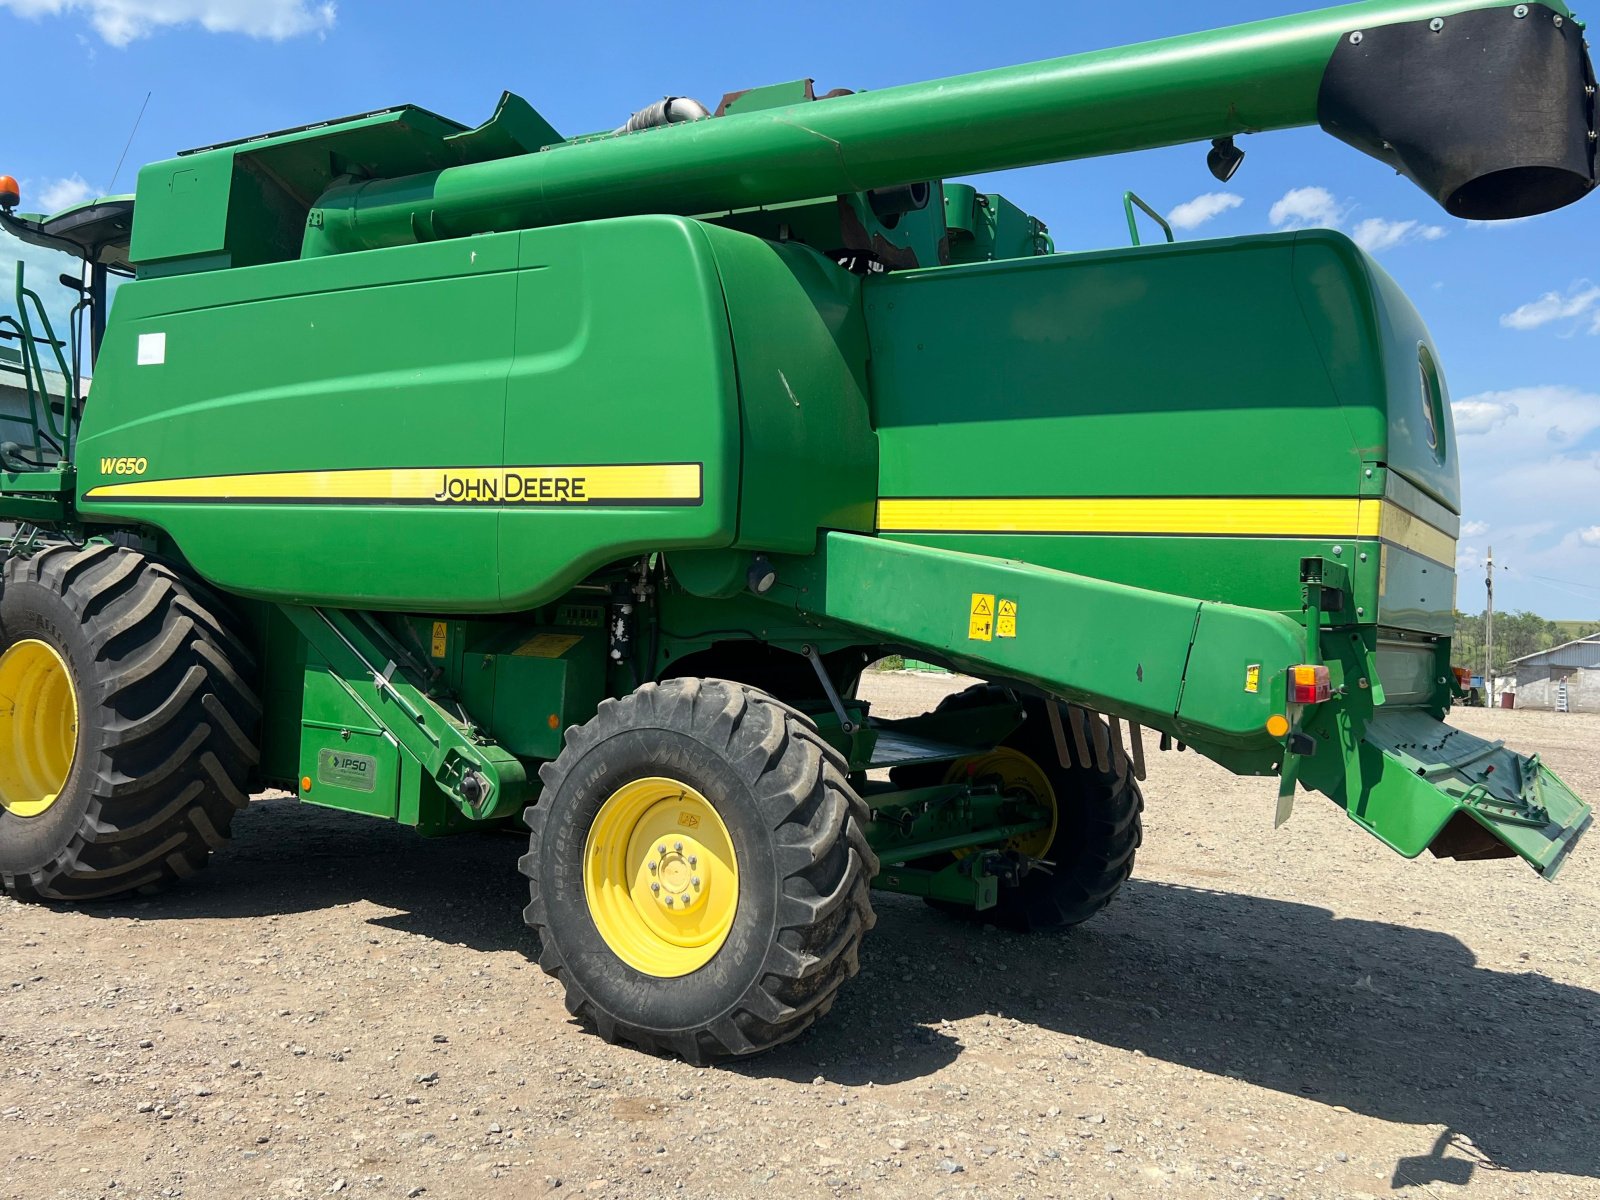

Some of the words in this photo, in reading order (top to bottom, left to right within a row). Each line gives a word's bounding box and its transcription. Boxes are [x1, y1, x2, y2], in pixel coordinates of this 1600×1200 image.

[101, 457, 148, 475] W650
[435, 474, 498, 501] JOHN
[505, 473, 587, 500] DEERE
[341, 758, 367, 771] IPSO
[586, 761, 608, 788] IND
